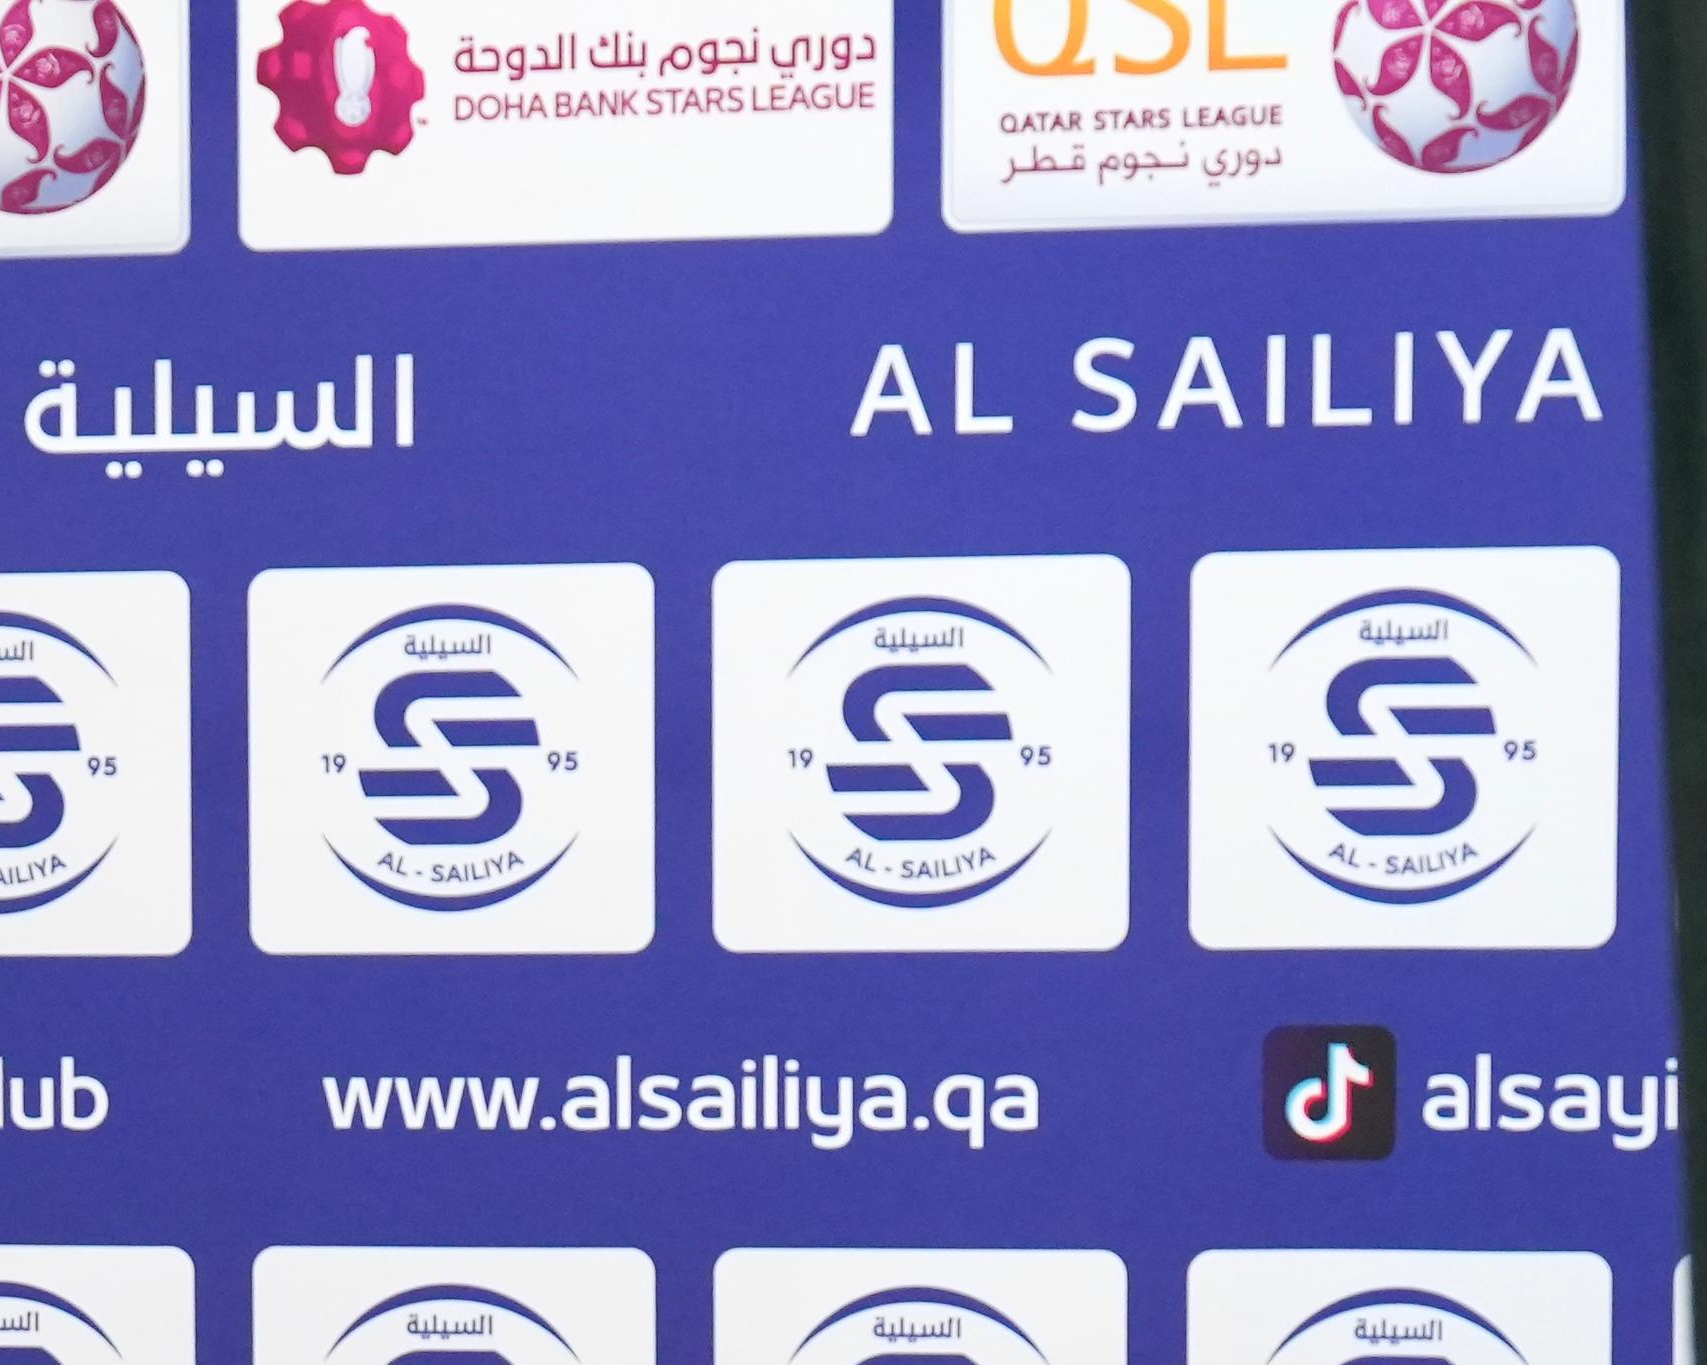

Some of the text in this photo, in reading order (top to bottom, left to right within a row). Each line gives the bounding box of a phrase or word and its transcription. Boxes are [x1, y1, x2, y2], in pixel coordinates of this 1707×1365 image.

[453, 27, 877, 83] دوري نجوم بنك الدوحة
[453, 82, 876, 122] DOHA BANK STARS LEAGUE
[999, 105, 1282, 135] QATAR STARS LEAGUE
[1001, 141, 1283, 187] دوري نجوم قطر
[851, 328, 1602, 436] AL SAILIYA
[25, 354, 413, 478] السيلية
[872, 626, 965, 655] السيلية
[786, 747, 815, 770] 19
[1018, 744, 1053, 768] 95
[844, 846, 998, 881] AL SAILIYA
[323, 1055, 1038, 1149] www.alsailiya.qa
